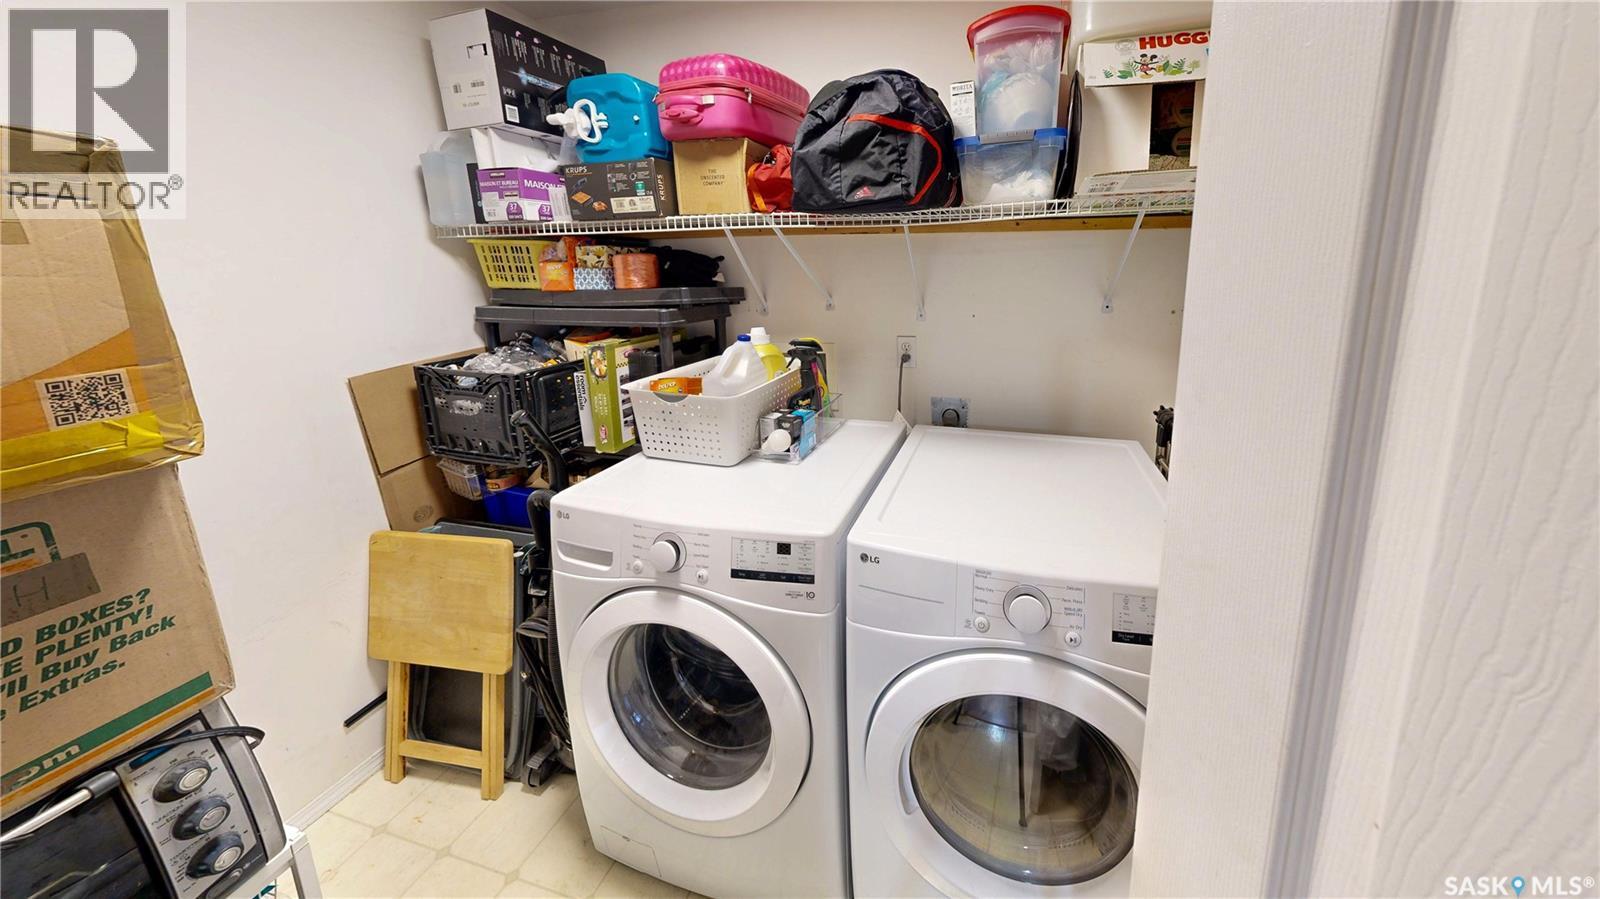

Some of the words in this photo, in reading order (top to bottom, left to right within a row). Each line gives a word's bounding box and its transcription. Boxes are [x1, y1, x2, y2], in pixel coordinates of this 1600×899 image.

[1139, 31, 1211, 50] HUGG
[565, 165, 588, 174] KRUPS
[656, 174, 665, 201] KRUPS
[542, 205, 550, 213] 37
[575, 375, 585, 411] essentials
[36, 588, 151, 645] BOXES?
[35, 604, 154, 666] PLENTY!
[40, 648, 100, 683] Buy
[109, 615, 177, 653] Back
[19, 660, 126, 713] Extras.
